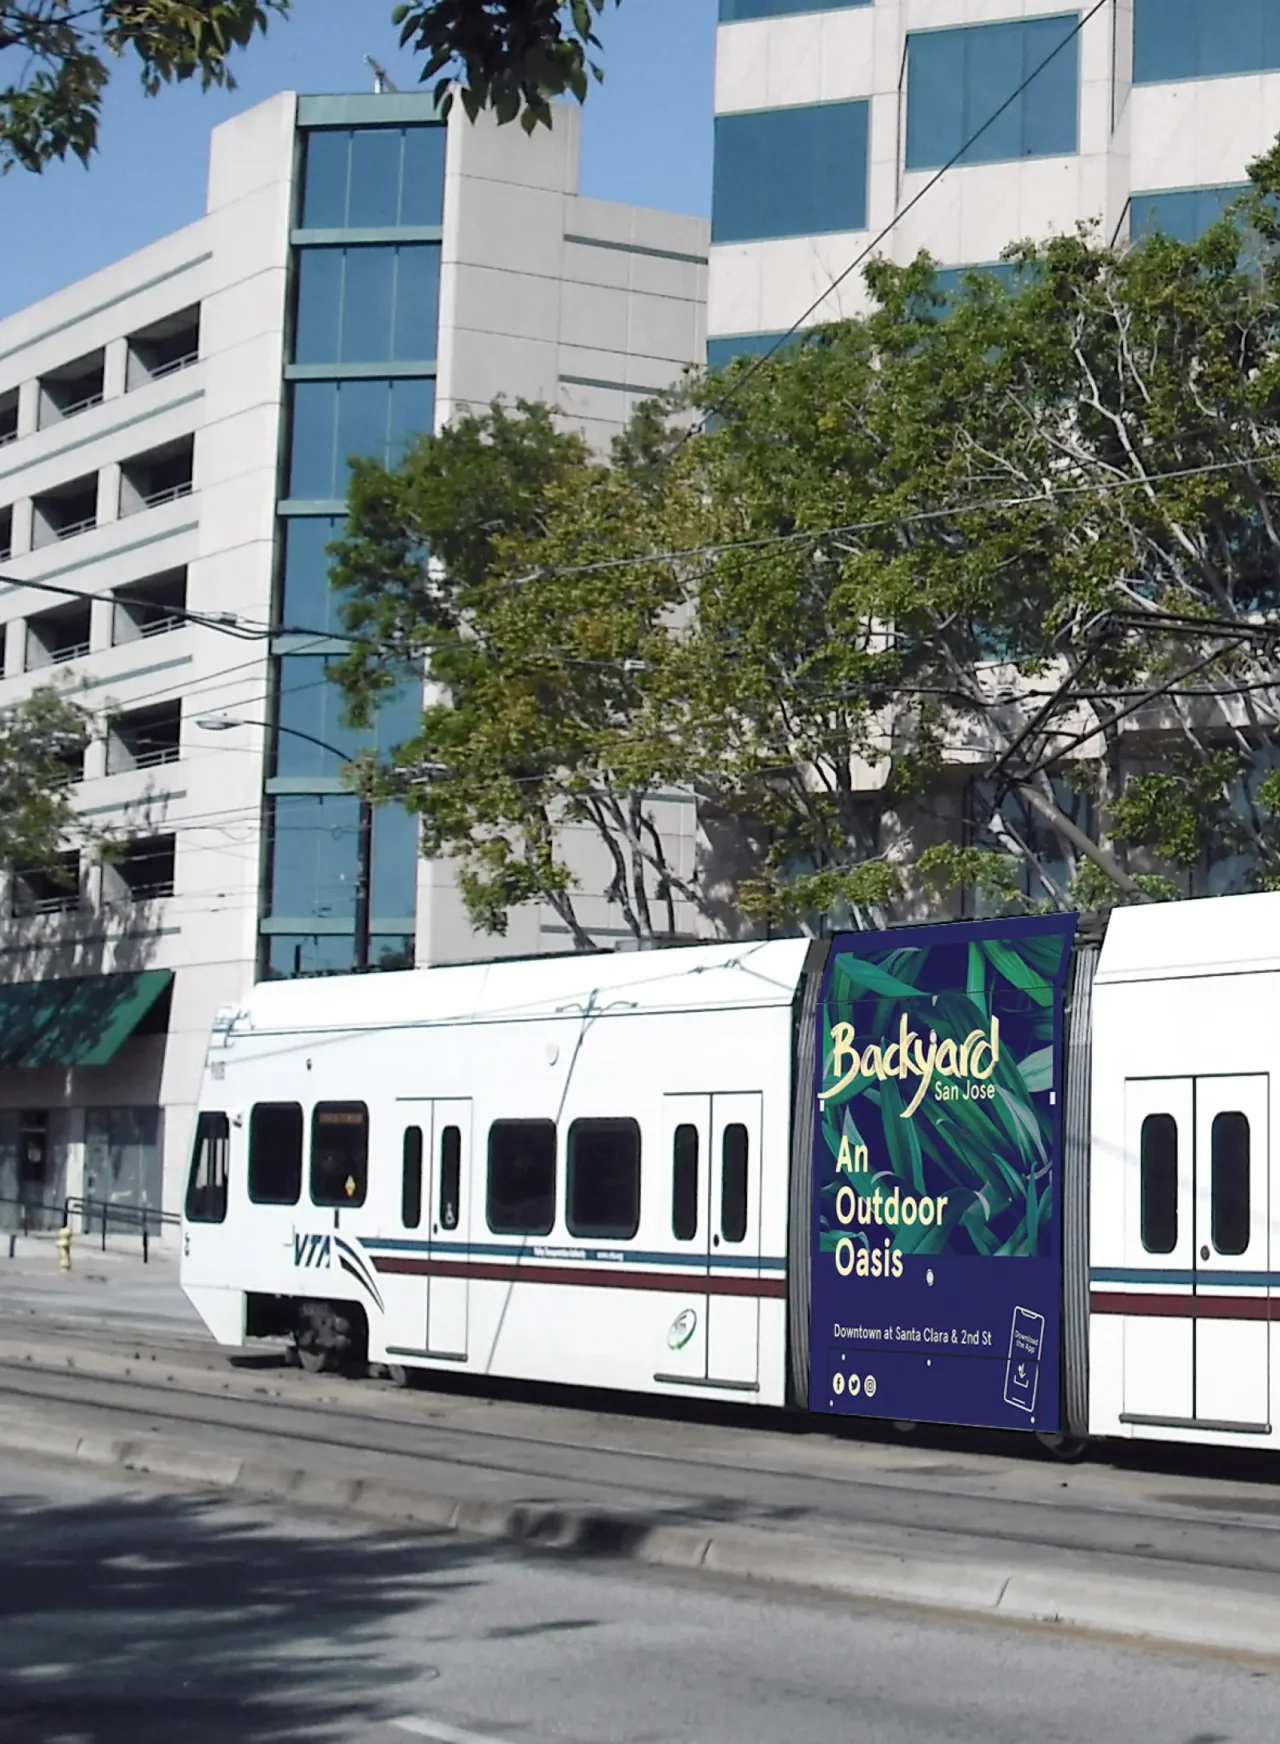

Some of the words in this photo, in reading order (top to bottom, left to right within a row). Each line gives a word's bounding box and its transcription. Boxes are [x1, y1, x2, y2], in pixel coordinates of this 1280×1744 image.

[817, 1012, 1000, 1118] Backyard
[934, 1080, 959, 1102] San
[962, 1079, 996, 1101] Jose
[835, 1135, 869, 1173] An
[835, 1186, 949, 1226] Outdoor
[294, 1232, 331, 1270] VTA
[835, 1237, 904, 1278] Oasis
[834, 1323, 882, 1340] Downtown
[883, 1328, 893, 1341] at
[895, 1326, 921, 1342] Santa
[923, 1327, 949, 1344] Clara
[951, 1329, 958, 1344] &
[960, 1329, 979, 1345] 2nd
[982, 1330, 992, 1346] St
[1014, 1329, 1039, 1346] Download
